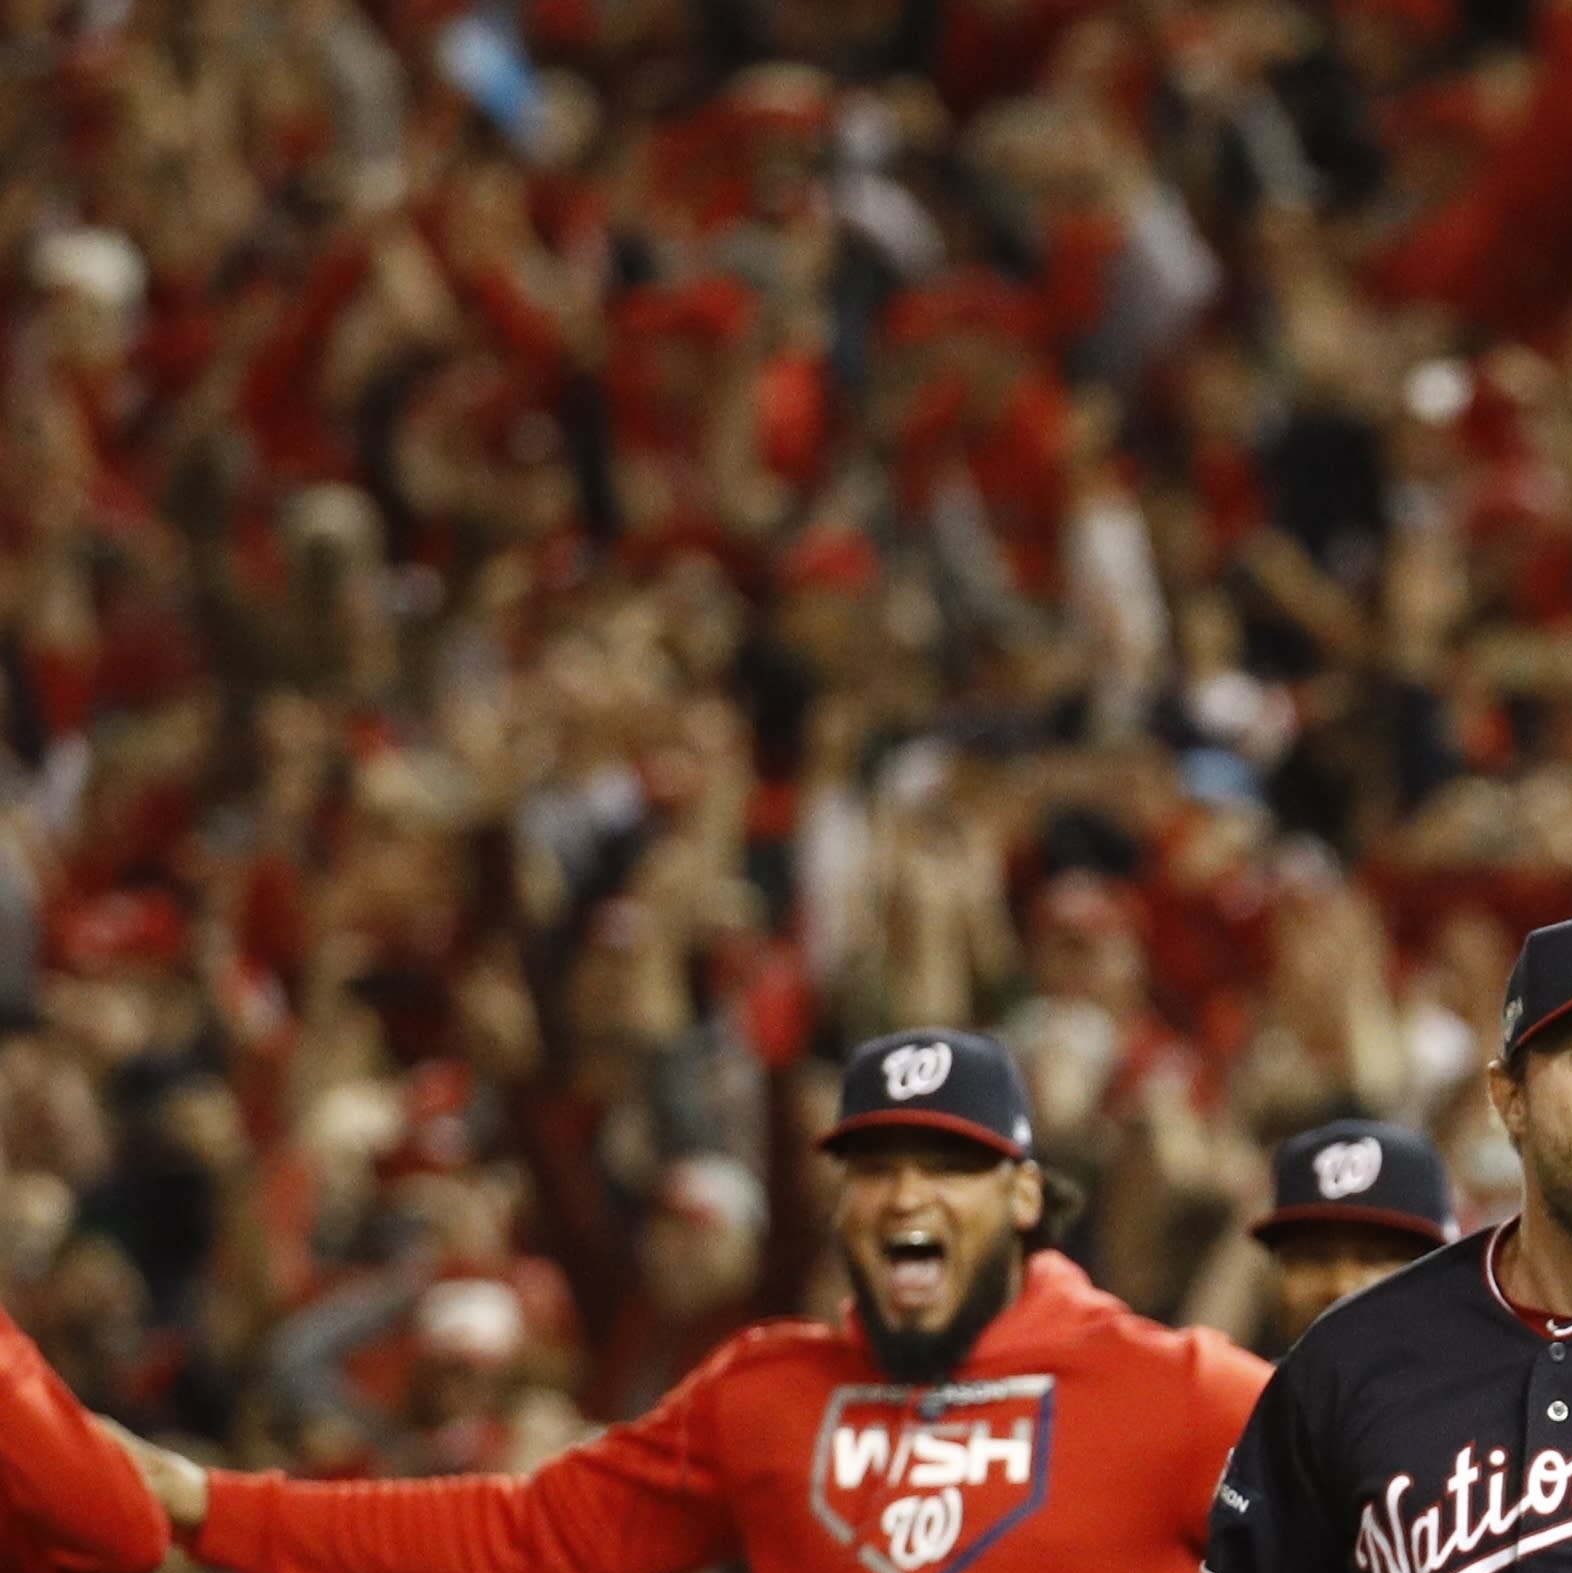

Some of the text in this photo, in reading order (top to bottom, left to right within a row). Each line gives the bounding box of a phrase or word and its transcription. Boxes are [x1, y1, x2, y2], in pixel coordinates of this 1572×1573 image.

[881, 1041, 953, 1101] W
[1311, 1136, 1383, 1200] W
[832, 1417, 1034, 1490] WSH
[880, 1486, 964, 1572] W
